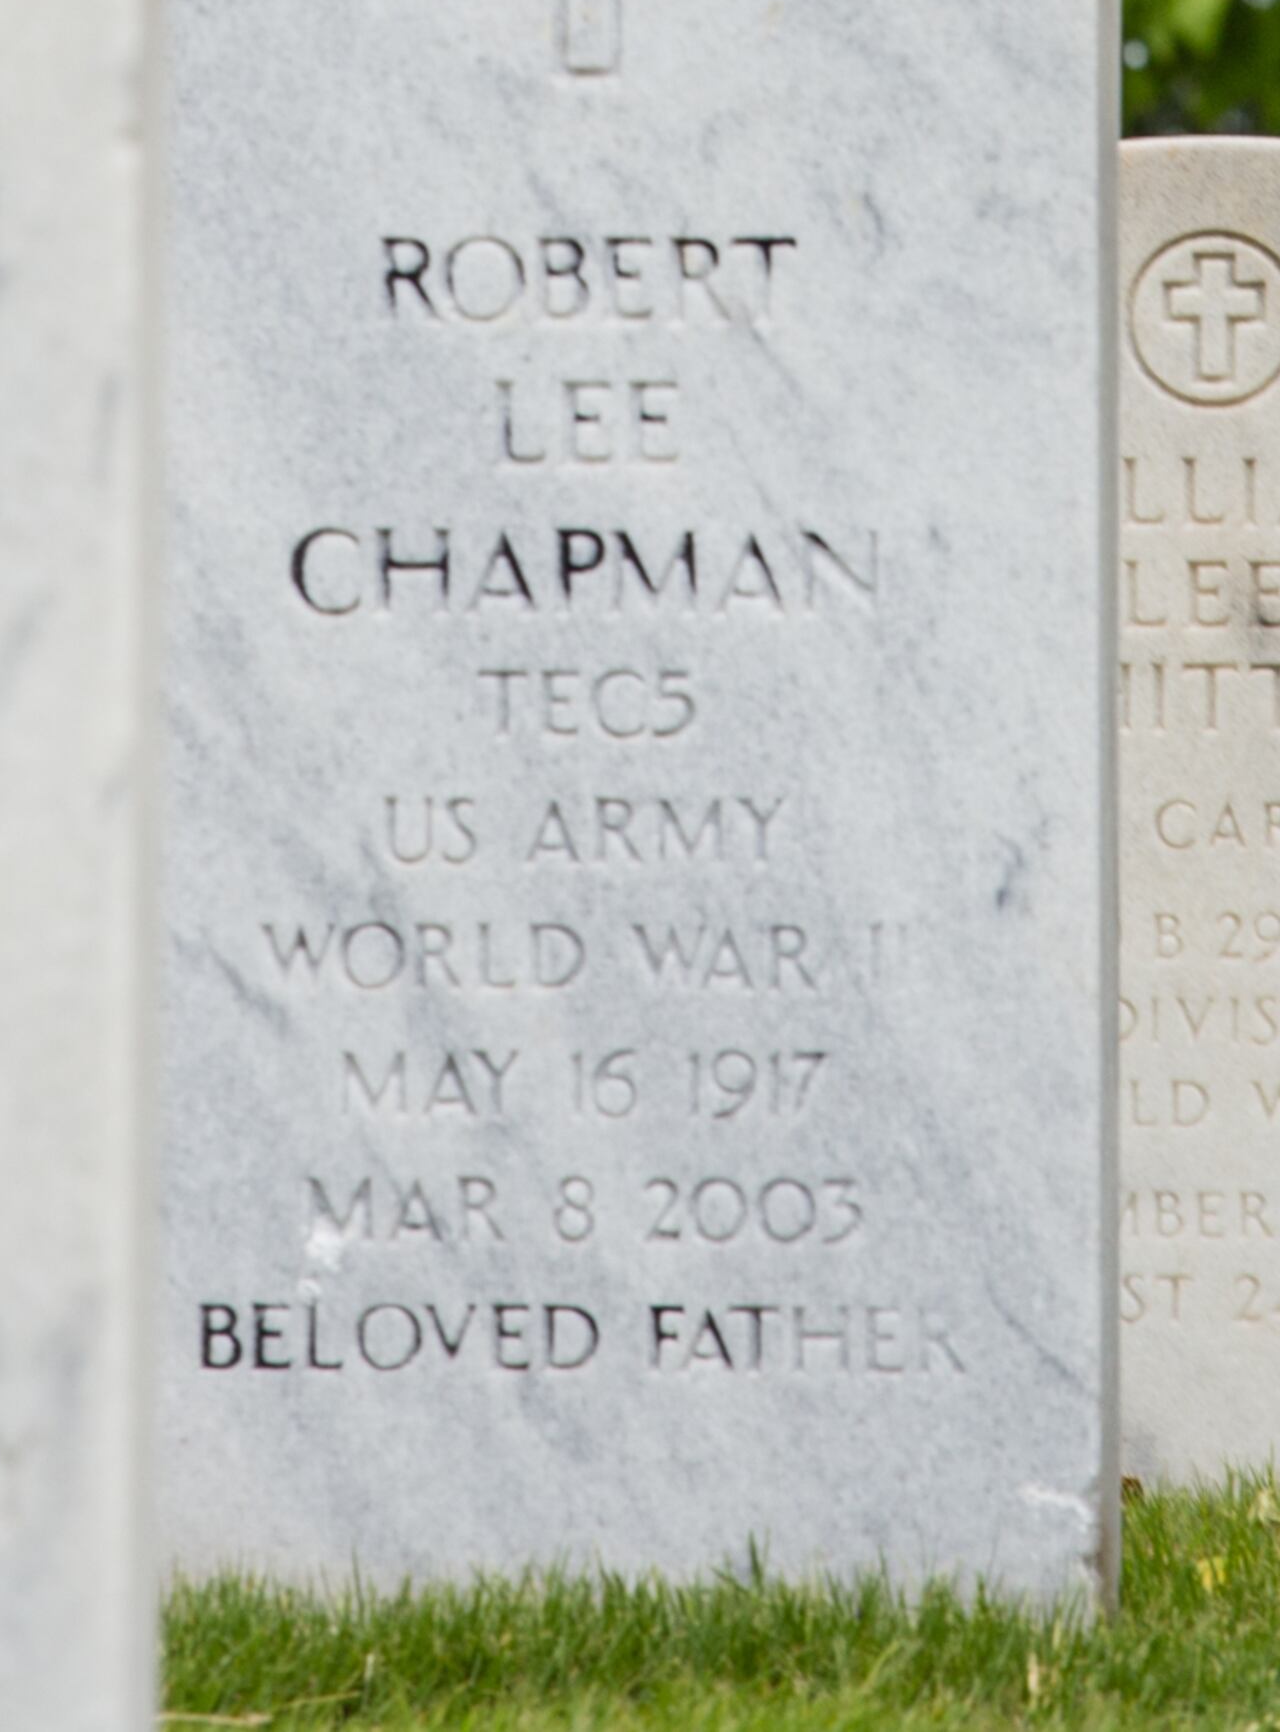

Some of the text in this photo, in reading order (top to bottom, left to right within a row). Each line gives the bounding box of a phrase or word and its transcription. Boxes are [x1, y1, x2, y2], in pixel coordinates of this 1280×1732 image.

[380, 235, 798, 323] ROBERT
[494, 379, 680, 464] LEE
[290, 527, 880, 614] CHAPMAN
[477, 667, 698, 738] TEC5
[383, 795, 786, 864] US ARMY
[262, 921, 587, 989] WORLD
[632, 922, 818, 991] WAR
[1153, 912, 1185, 960] B
[340, 1047, 832, 1119] MAY 16 1917
[1129, 1079, 1212, 1128] LD
[307, 1175, 865, 1244] MAR 8 2003
[1119, 1273, 1194, 1324] ST
[197, 1302, 969, 1374] BELOVED FATHER
